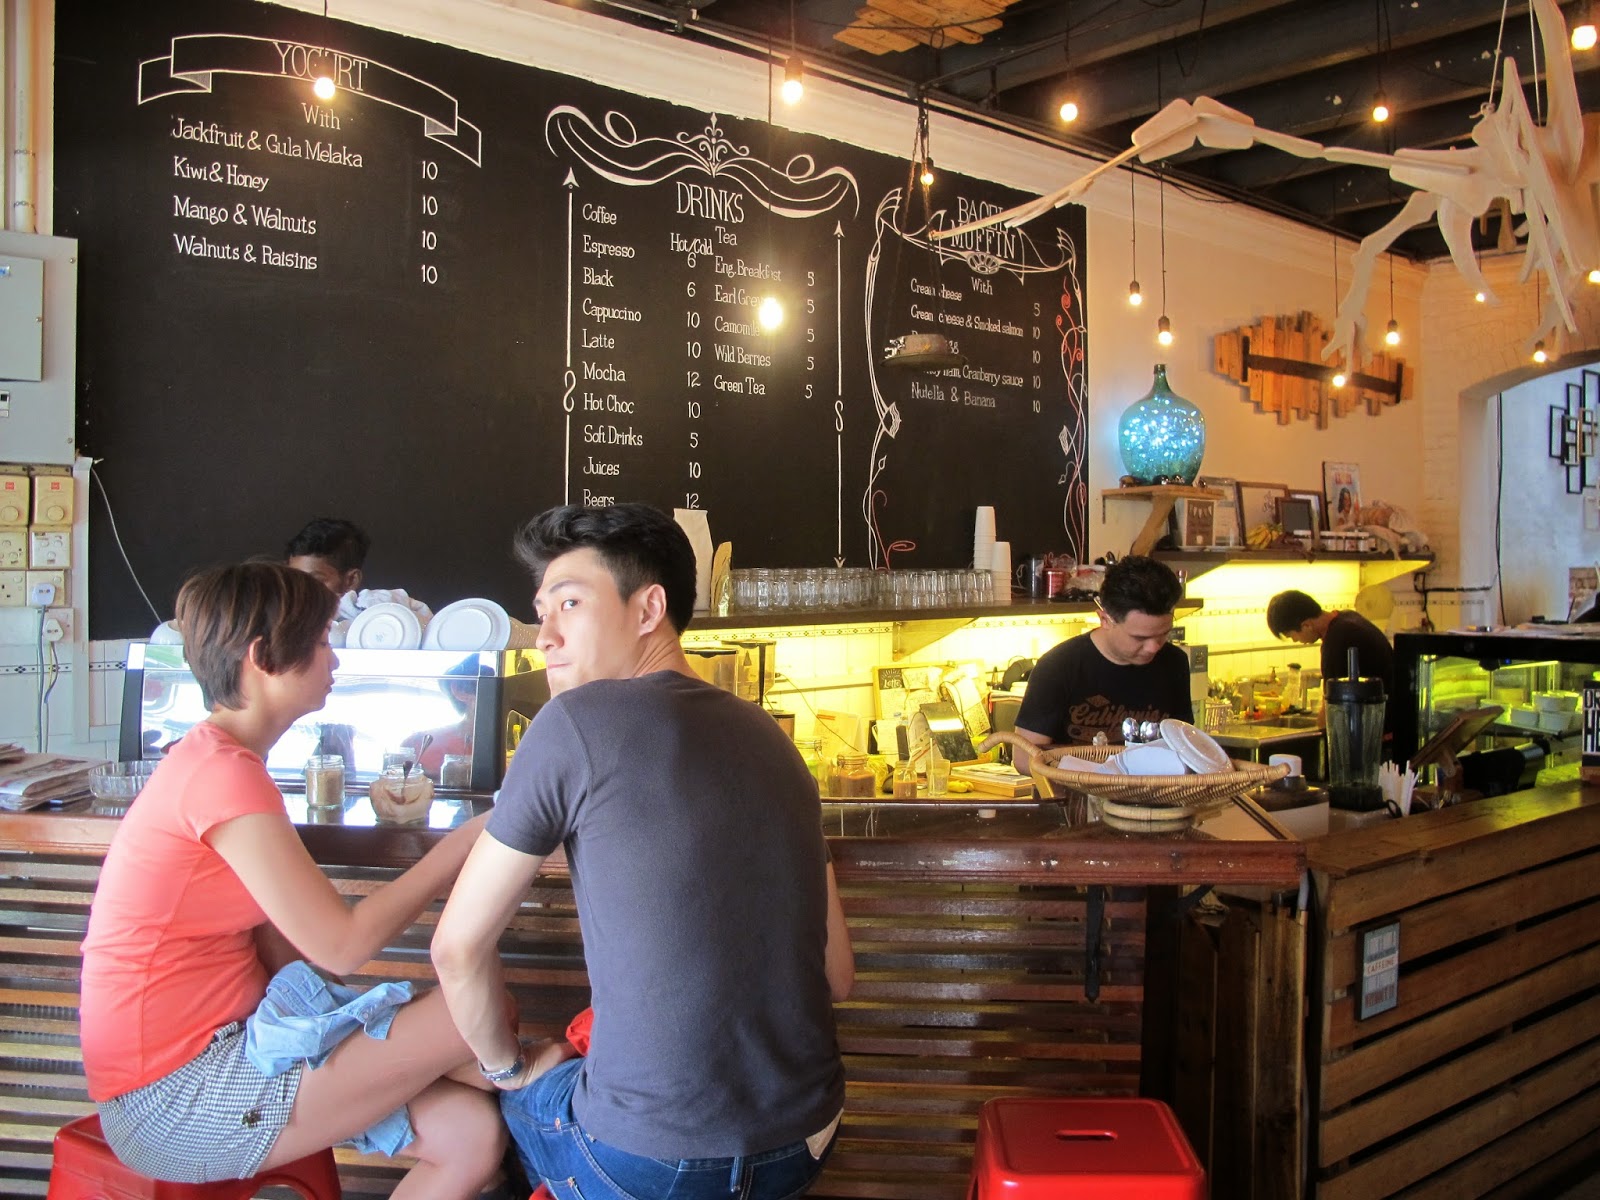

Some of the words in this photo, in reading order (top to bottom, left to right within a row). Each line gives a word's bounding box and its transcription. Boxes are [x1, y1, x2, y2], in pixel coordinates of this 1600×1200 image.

[301, 102, 341, 130] With
[172, 117, 245, 149] Jackfruit
[247, 130, 261, 150] &
[266, 134, 302, 158] Gula
[305, 140, 363, 167] Melaka
[174, 156, 208, 182] Kiwi
[209, 162, 223, 183] &
[227, 165, 269, 192] Honey
[421, 160, 438, 180] 10
[422, 195, 438, 215] 10
[676, 181, 745, 224] DRINKS
[173, 195, 229, 225] Mango
[233, 204, 248, 226] &
[251, 205, 317, 235] Walnuts
[582, 203, 617, 225] Coffee
[422, 230, 438, 250] 10
[714, 225, 738, 246] Tea
[173, 233, 240, 261] Walnuts
[243, 244, 257, 263] &
[262, 245, 318, 270] Raisins
[583, 235, 635, 259] Espresso
[687, 251, 697, 269] 6
[421, 264, 438, 284] 10
[583, 266, 614, 287] Black
[807, 271, 815, 287] 5
[687, 281, 697, 298] 6
[714, 284, 736, 305] Earl
[971, 276, 993, 296] With
[582, 297, 642, 323] Cappuccino
[807, 299, 815, 314] 5
[686, 311, 701, 328] 10
[966, 315, 973, 328] &
[974, 316, 1001, 333] Smoked
[1002, 322, 1024, 337] salmon
[581, 328, 615, 350] Latte
[807, 328, 815, 342] 5
[1033, 326, 1041, 340] 10
[687, 341, 702, 359] 10
[714, 343, 735, 364] Wild
[737, 347, 771, 368] Berries
[1033, 351, 1041, 364] 10
[582, 361, 627, 382] Mocha
[807, 356, 815, 371] 5
[687, 371, 702, 388] 12
[714, 374, 743, 394] Green
[745, 377, 766, 396] Tea
[962, 364, 1000, 387] Cranberry
[1001, 374, 1024, 388] sauce
[1033, 375, 1041, 389] 10
[804, 384, 813, 400] 5
[911, 381, 945, 401] Nutella
[950, 386, 959, 402] &
[964, 391, 996, 408] Banana
[583, 393, 604, 413] Hot
[606, 394, 635, 414] Choc
[687, 401, 701, 419] 10
[1033, 400, 1041, 414] 10
[584, 424, 606, 445] Soft
[608, 426, 643, 447] Drinks
[690, 432, 699, 448] 5
[583, 456, 620, 476] Juices
[689, 461, 701, 479] 10
[583, 488, 615, 508] Beers
[686, 492, 700, 509] 12
